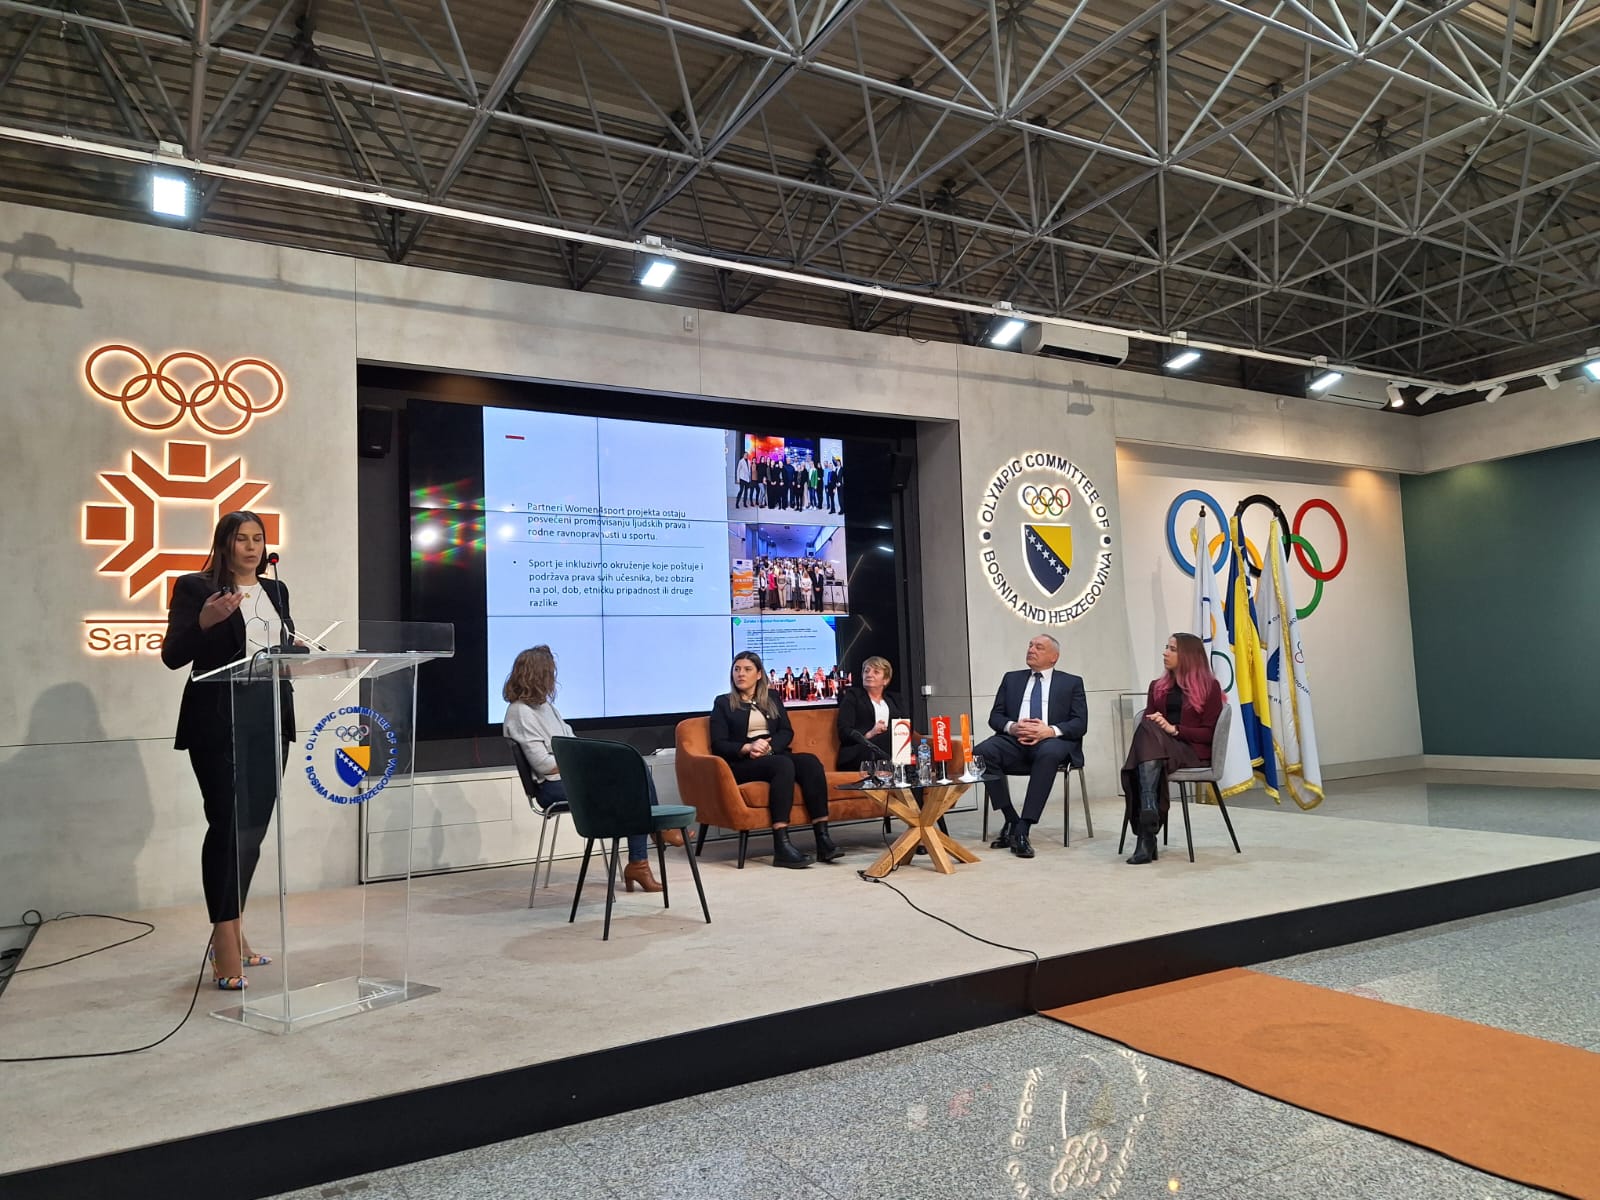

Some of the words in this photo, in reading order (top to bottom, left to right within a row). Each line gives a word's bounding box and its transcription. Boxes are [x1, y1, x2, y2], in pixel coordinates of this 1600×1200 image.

[982, 460, 1023, 523] OLYMPIC
[1025, 453, 1100, 503] COMMITTEE
[1096, 506, 1110, 527] OF
[527, 502, 563, 512] Partneri
[627, 507, 660, 517] projekta
[662, 509, 686, 518] ostaju
[527, 514, 572, 524] posvećeni
[574, 518, 630, 528] promovisanju
[632, 519, 663, 528] ljudskih
[528, 528, 555, 537] rodne
[528, 559, 553, 570] Sport
[554, 559, 563, 570] je
[565, 559, 608, 568] inkluzivno
[610, 561, 650, 571] okruženje
[652, 561, 669, 571] koje
[670, 562, 699, 572] poštuje
[529, 572, 570, 582] podržava
[615, 573, 653, 584] učesnika,
[655, 574, 669, 582] bez
[670, 574, 694, 583] obzira
[543, 586, 560, 595] pol,
[562, 586, 581, 595] dob,
[583, 586, 614, 594] etničku
[616, 587, 660, 596] pripadnost
[670, 587, 694, 596] druge
[984, 550, 1019, 608] BOSNIA
[1018, 601, 1046, 622] AND
[1048, 552, 1112, 623] HERZEGOVINA
[87, 627, 164, 651] Sara
[306, 711, 337, 751] OLYMPIC
[327, 793, 348, 805] AND
